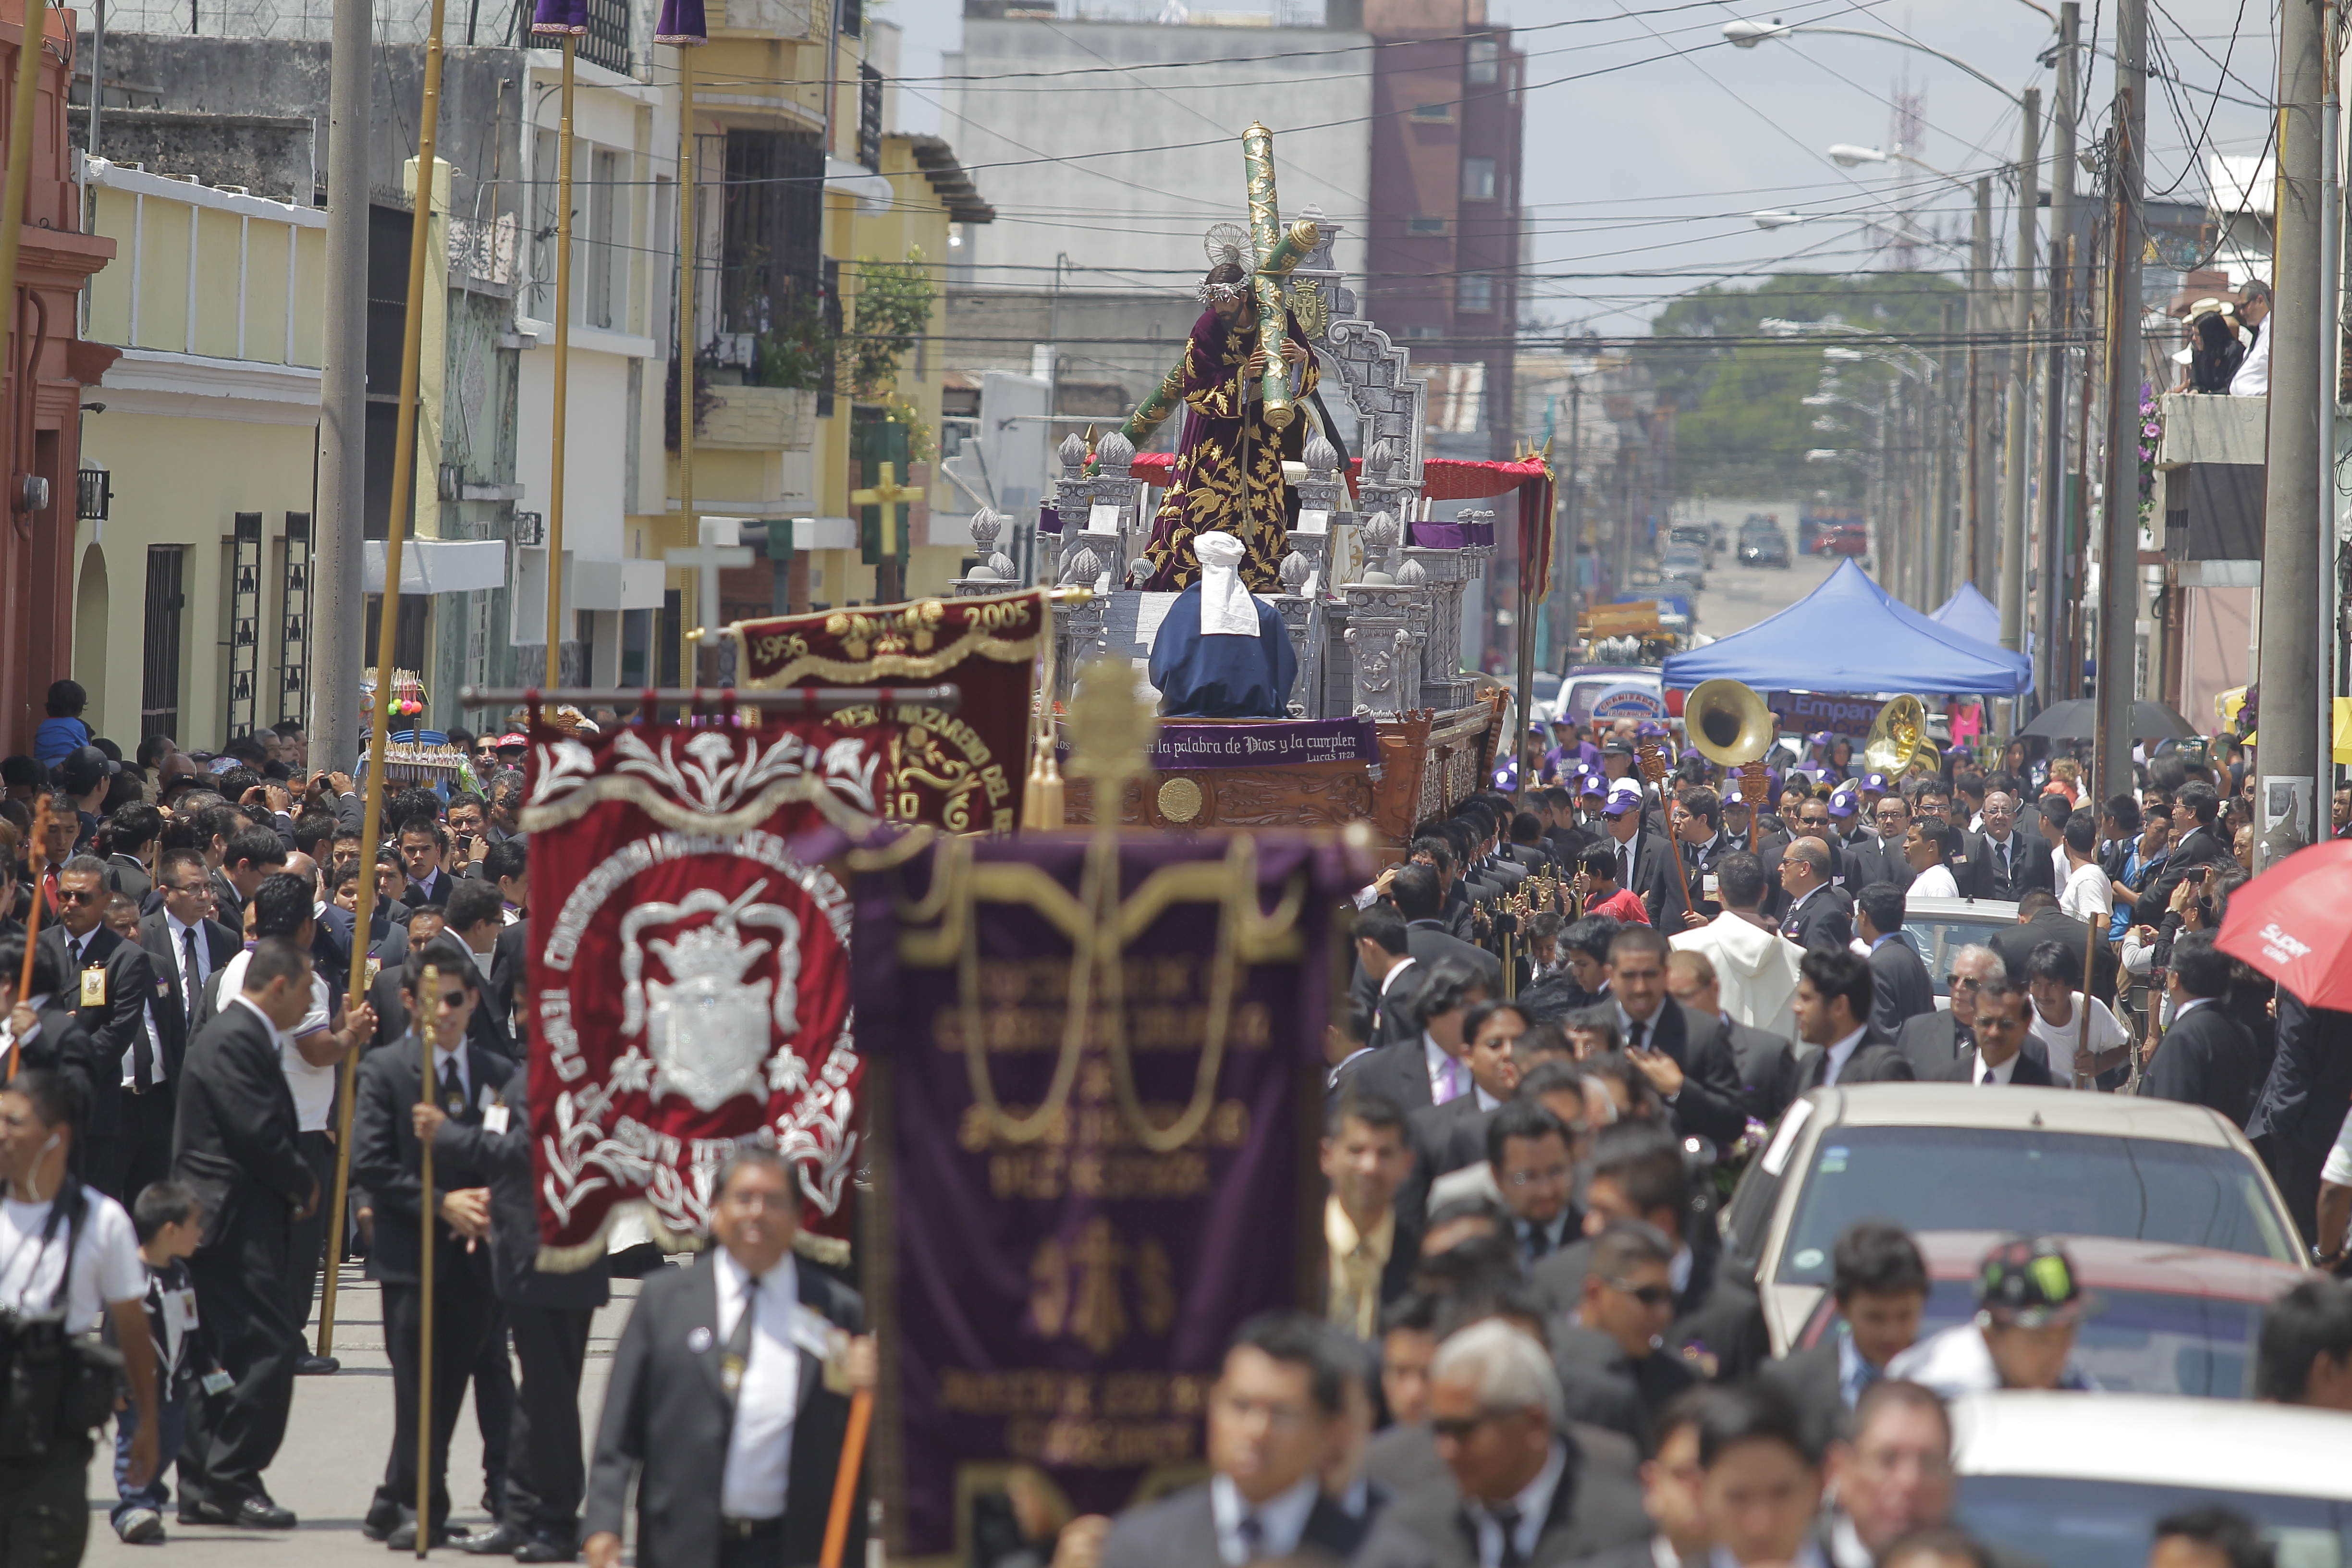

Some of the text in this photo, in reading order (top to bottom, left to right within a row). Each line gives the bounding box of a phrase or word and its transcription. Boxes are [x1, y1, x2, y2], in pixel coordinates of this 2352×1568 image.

[963, 600, 1030, 636] 2005
[752, 631, 808, 664] 1956
[897, 704, 992, 767] NAZARENO
[980, 763, 1010, 807] DEL
[1055, 734, 1071, 751] los
[1158, 738, 1171, 753] la
[1174, 736, 1222, 758] palabra
[1225, 736, 1241, 754] de
[1243, 735, 1276, 755] Dios
[1279, 740, 1288, 754] y
[1290, 733, 1304, 748] la
[1307, 731, 1356, 753] cumplen
[1307, 751, 1355, 762] Lucas 11:28
